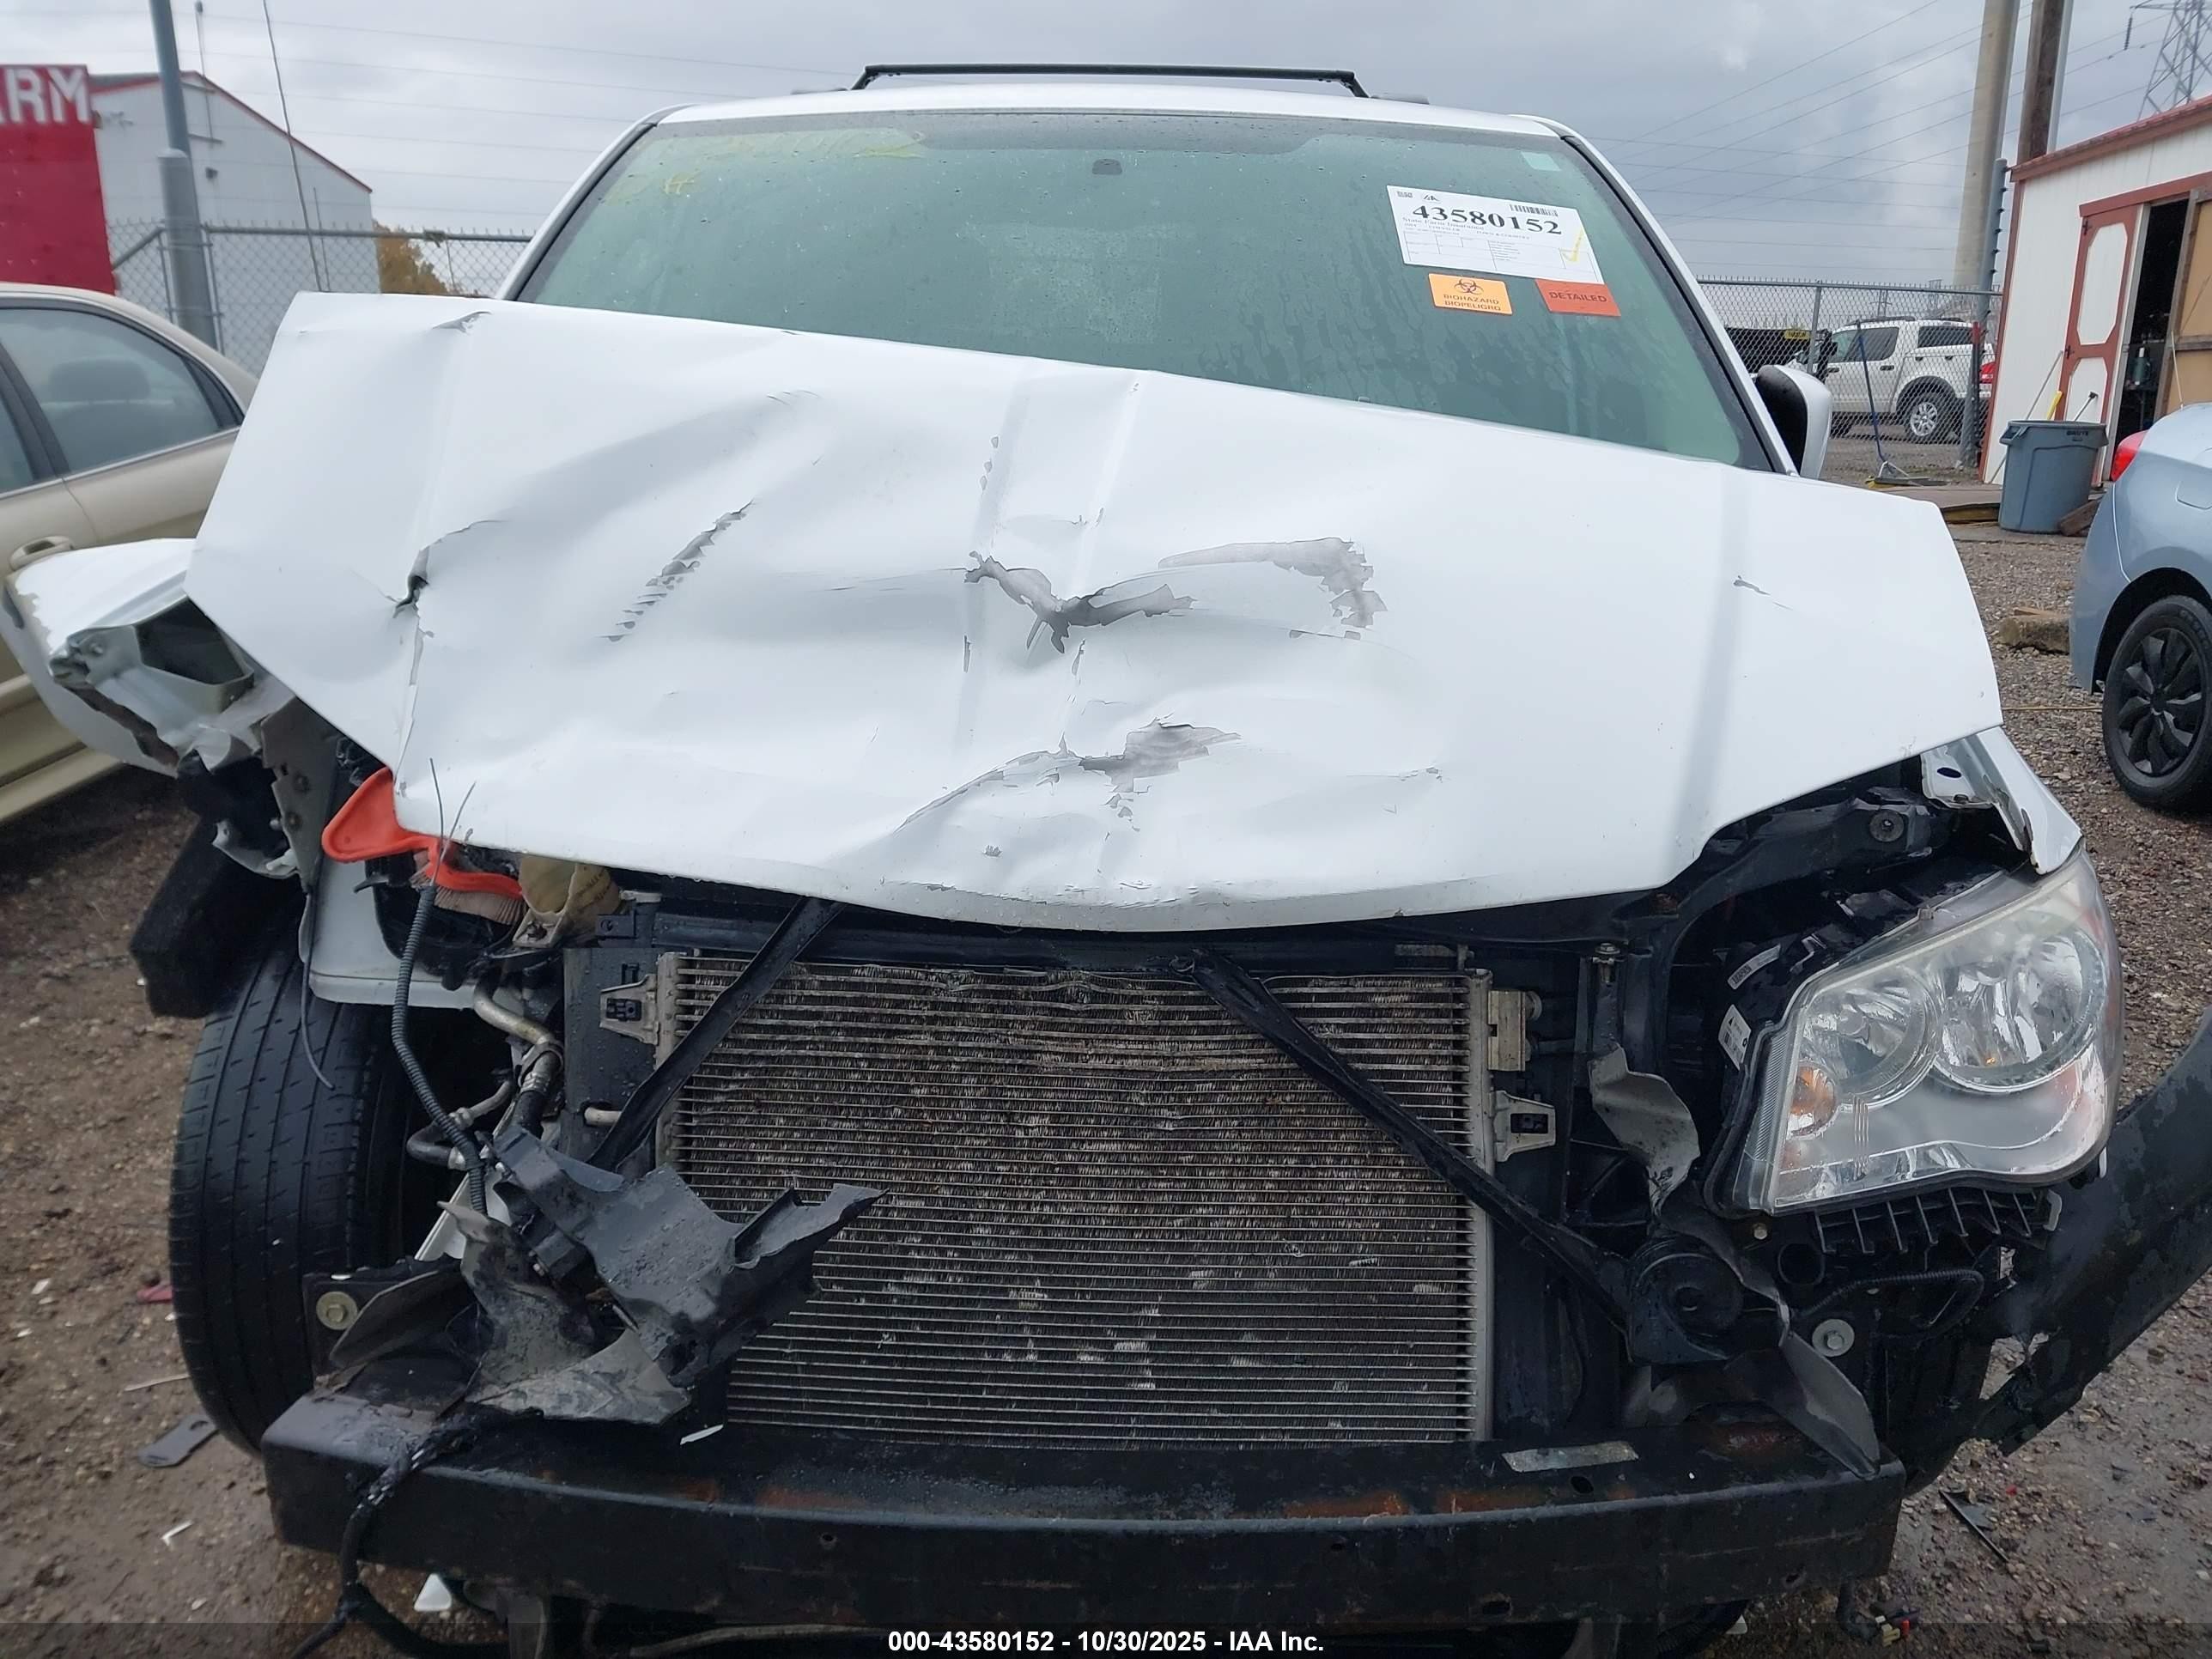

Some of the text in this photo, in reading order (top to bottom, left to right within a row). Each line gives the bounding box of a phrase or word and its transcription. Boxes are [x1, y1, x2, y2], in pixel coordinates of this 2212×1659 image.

[0, 67, 89, 125] RM
[1413, 205, 1562, 235] 43580152
[1443, 294, 1500, 305] BIOHAZARD
[1549, 291, 1607, 302] DETAILED
[1444, 301, 1502, 311] BIOPELIGRO
